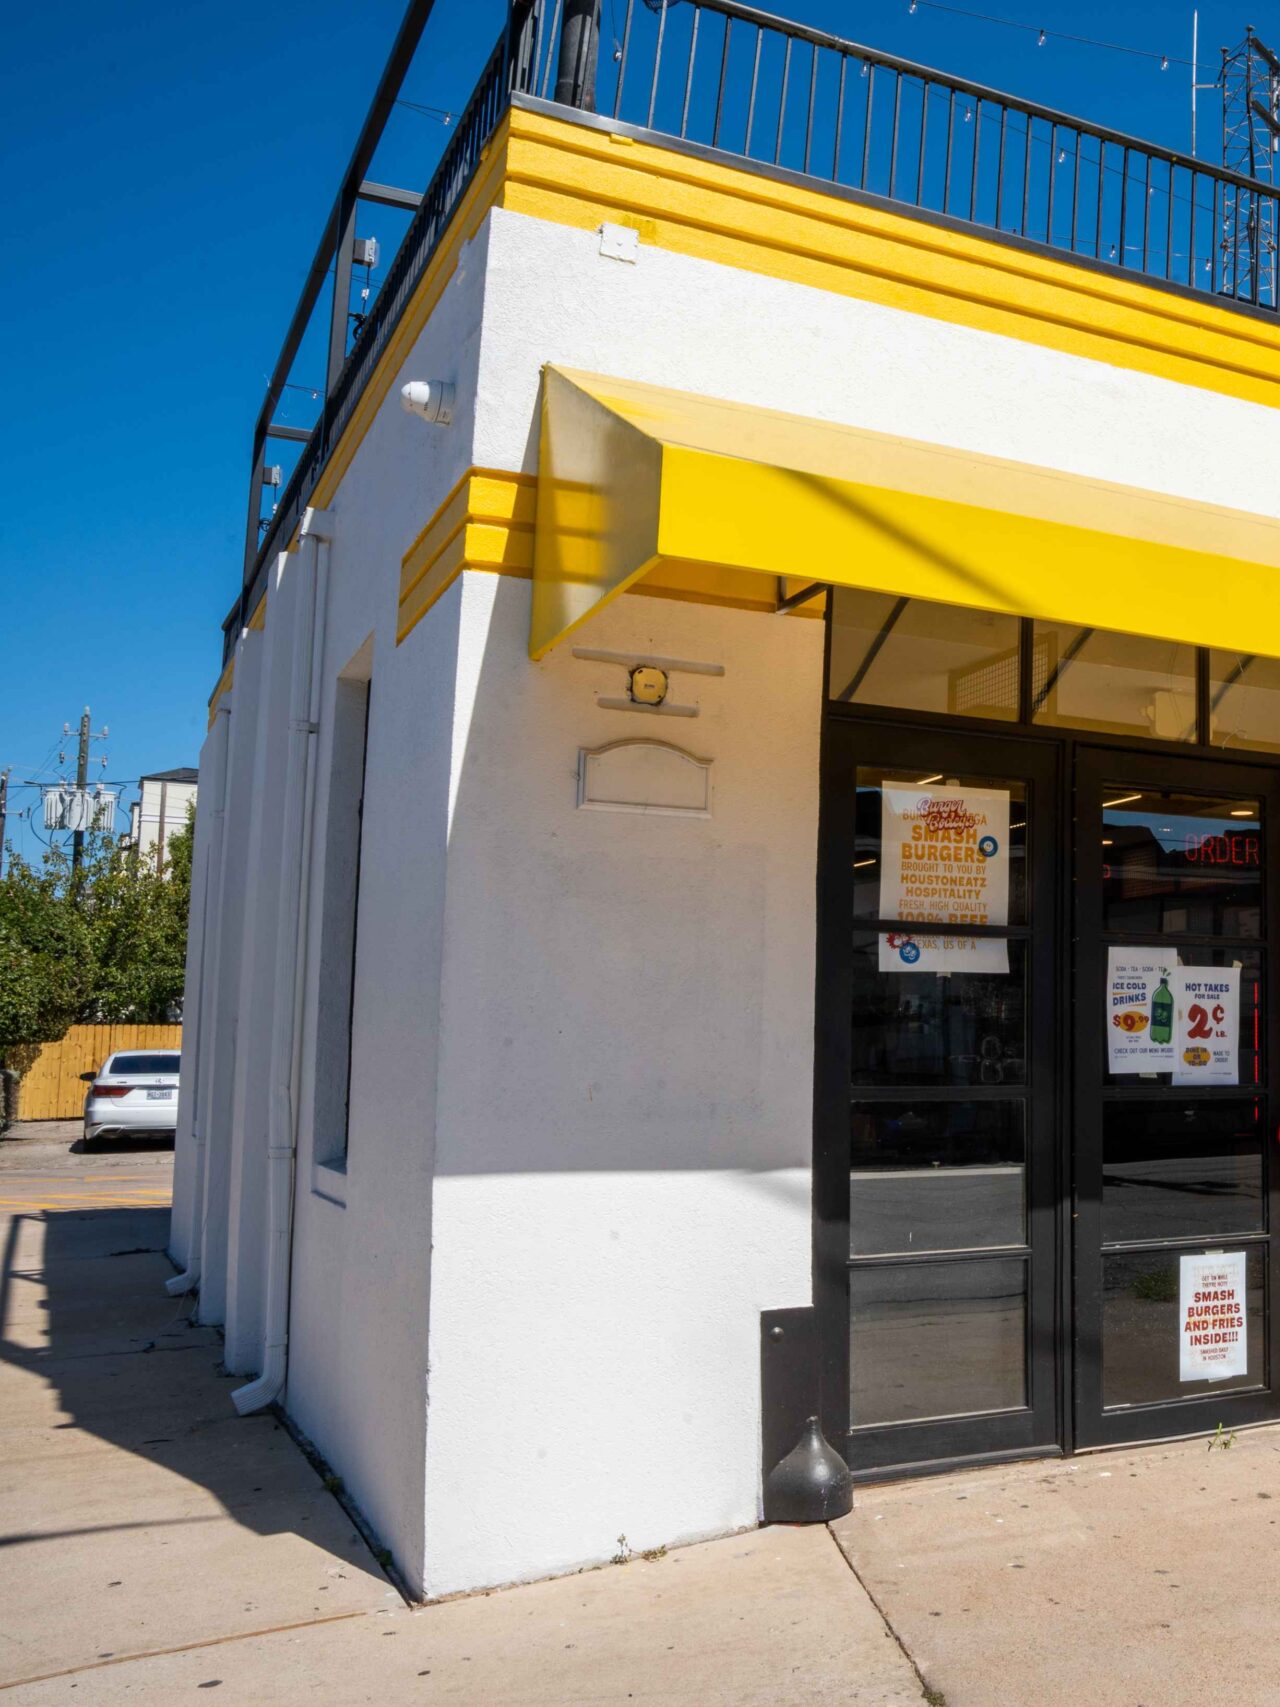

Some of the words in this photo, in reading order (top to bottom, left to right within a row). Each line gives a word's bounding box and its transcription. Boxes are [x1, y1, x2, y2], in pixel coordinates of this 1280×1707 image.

[911, 825, 977, 844] SMASH
[902, 843, 986, 863] BURGERS
[1184, 832, 1259, 865] ORDER
[901, 862, 938, 872] BROUGHT
[944, 863, 952, 872] TO
[957, 864, 972, 874] YOU
[976, 864, 985, 874] BY
[901, 874, 986, 887] HOUSTONEATZ
[906, 887, 981, 899] HOSPITALITY
[930, 901, 948, 911] HIGH
[953, 902, 988, 912] QUALITY
[944, 940, 953, 949] US
[958, 940, 967, 950] OF
[971, 941, 976, 950] A
[1185, 983, 1202, 991] HOT
[1204, 983, 1229, 992] TAKES
[1113, 993, 1146, 1006] DRINKS
[1194, 1289, 1234, 1302] SMASH
[1188, 1303, 1240, 1317] BURGERS
[1184, 1321, 1208, 1332] AND
[1212, 1317, 1243, 1329] FRIES
[1190, 1331, 1238, 1346] INSIDE!!!
